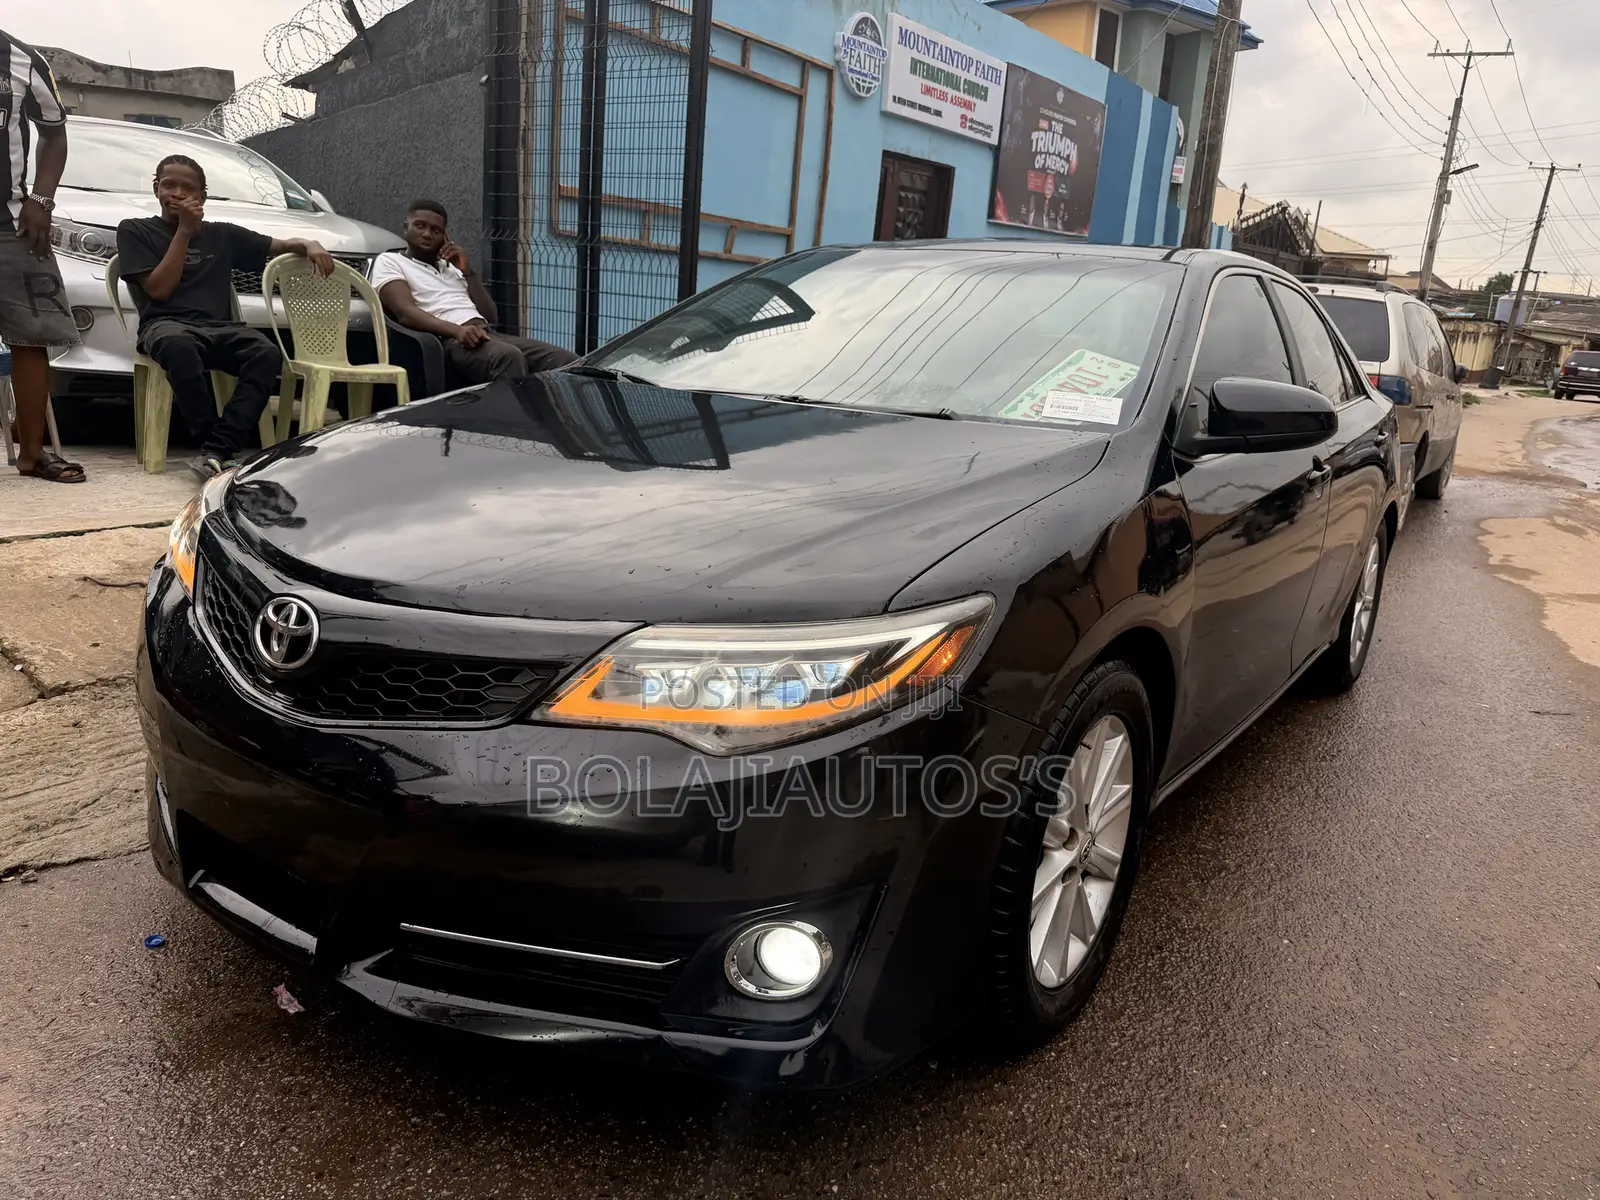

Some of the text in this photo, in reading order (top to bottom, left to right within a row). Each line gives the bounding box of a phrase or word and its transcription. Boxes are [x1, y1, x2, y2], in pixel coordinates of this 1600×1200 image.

[841, 34, 887, 62] MOUNTAINTOP
[849, 48, 882, 75] FAITH
[898, 26, 1003, 86] MOUNTAINTOP FAITH
[909, 57, 989, 103] INTERNATIONAL CHURCH
[920, 83, 948, 104] LIMITLESS
[950, 92, 977, 113] ASSEMBLY
[1051, 120, 1064, 134] THE
[1031, 131, 1078, 163] TRIUMPH
[1034, 153, 1069, 176] OF MERCY
[23, 272, 71, 318] R
